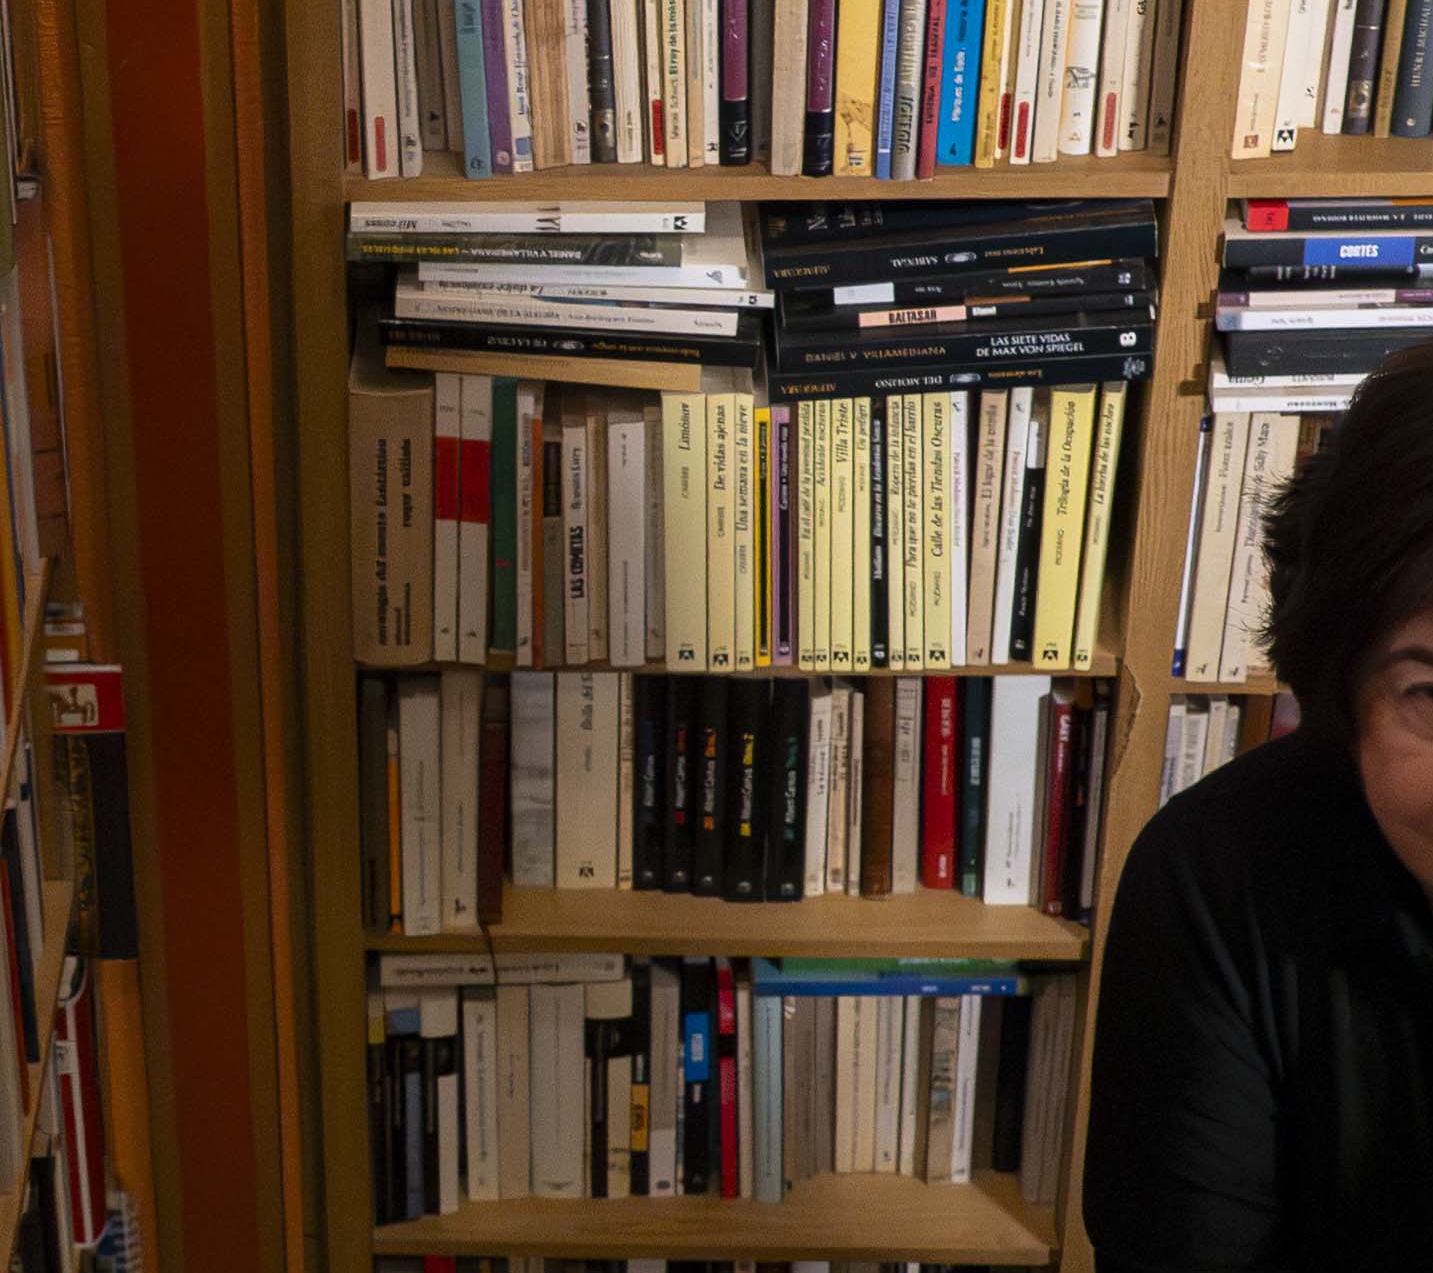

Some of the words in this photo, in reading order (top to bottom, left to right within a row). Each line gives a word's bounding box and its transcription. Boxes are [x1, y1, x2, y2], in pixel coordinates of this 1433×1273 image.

[1340, 243, 1379, 259] CORTÉS
[888, 310, 937, 324] BALTASAR
[976, 347, 990, 357] DE
[992, 345, 1017, 357] MAX
[1019, 344, 1043, 355] VON
[1045, 343, 1085, 354] SPIEGEL
[990, 334, 1008, 345] LAS
[1010, 333, 1036, 345] SIETE
[1039, 332, 1071, 344] VIDAS
[715, 405, 727, 440] ajenas
[737, 405, 748, 435] nieve
[835, 403, 849, 436] Triste
[931, 402, 943, 447] Oscuras
[714, 443, 726, 472] vidas
[738, 450, 748, 464] en
[835, 439, 849, 463] Villa
[714, 475, 725, 491] De
[931, 450, 943, 493] Tiendas
[737, 467, 749, 507] semana
[1056, 478, 1072, 516] Trilogía
[930, 496, 943, 510] las
[735, 510, 749, 532] Una
[930, 514, 943, 528] de
[929, 531, 943, 557] Calle
[905, 546, 917, 569] Para
